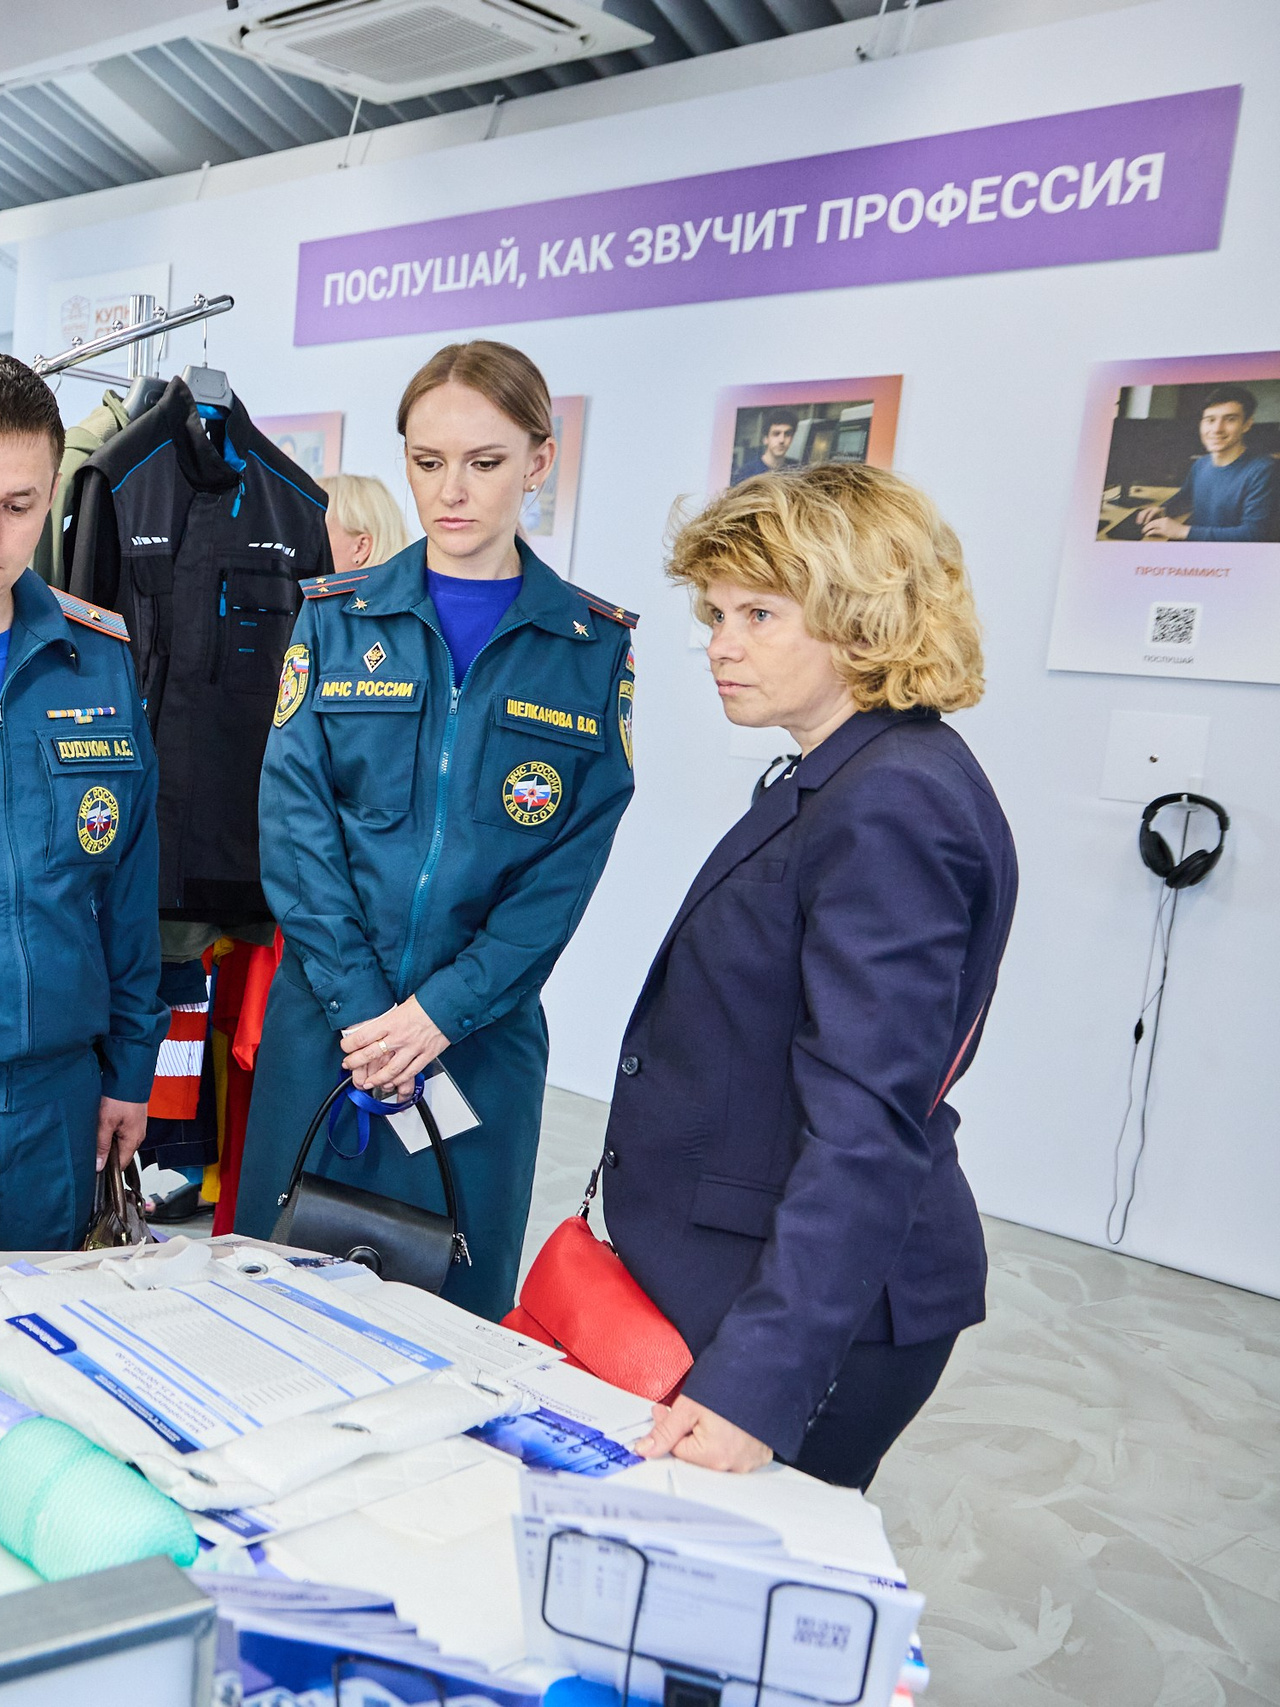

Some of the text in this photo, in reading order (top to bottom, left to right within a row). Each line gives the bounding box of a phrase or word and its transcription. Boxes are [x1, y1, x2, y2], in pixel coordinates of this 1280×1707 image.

[323, 152, 1166, 308] ПОСЛУШАЙ, КАК ЗВУЧИТ ПРОФЕССИЯ
[1135, 565, 1232, 578] ПРОГРАММИСТ
[321, 681, 414, 698] МЧС РОССИИ
[507, 699, 598, 736] ЩЕЛКАНОВА В.Ю.
[58, 740, 111, 759] ДУДУКИН
[507, 763, 560, 794] МЧС РОССИИ
[80, 788, 118, 820] МЧС РОССИИ
[505, 794, 556, 823] EMERCOM
[79, 828, 116, 852] EMERCOM
